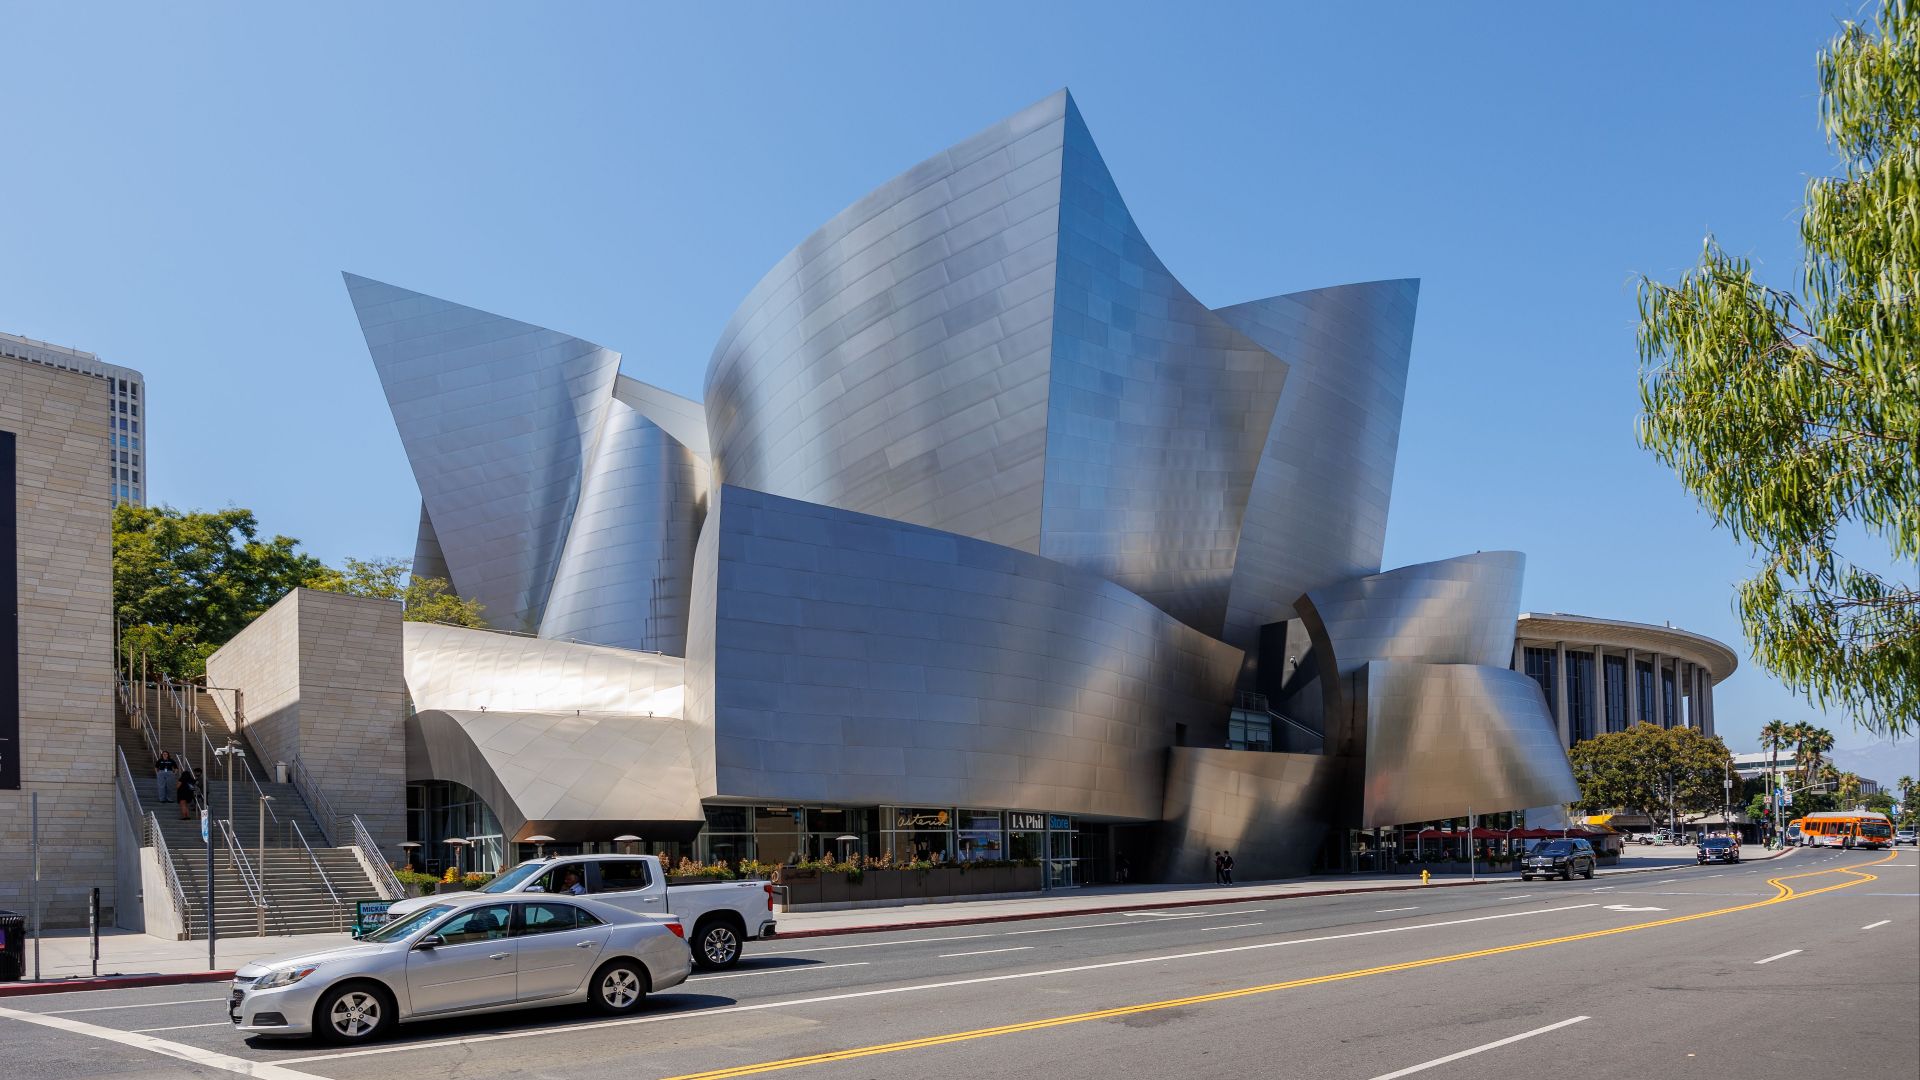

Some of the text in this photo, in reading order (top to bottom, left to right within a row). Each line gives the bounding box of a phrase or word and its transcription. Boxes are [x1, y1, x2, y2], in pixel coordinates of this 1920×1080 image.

[1012, 814, 1044, 829] LA Phil
[1049, 815, 1069, 829] Store
